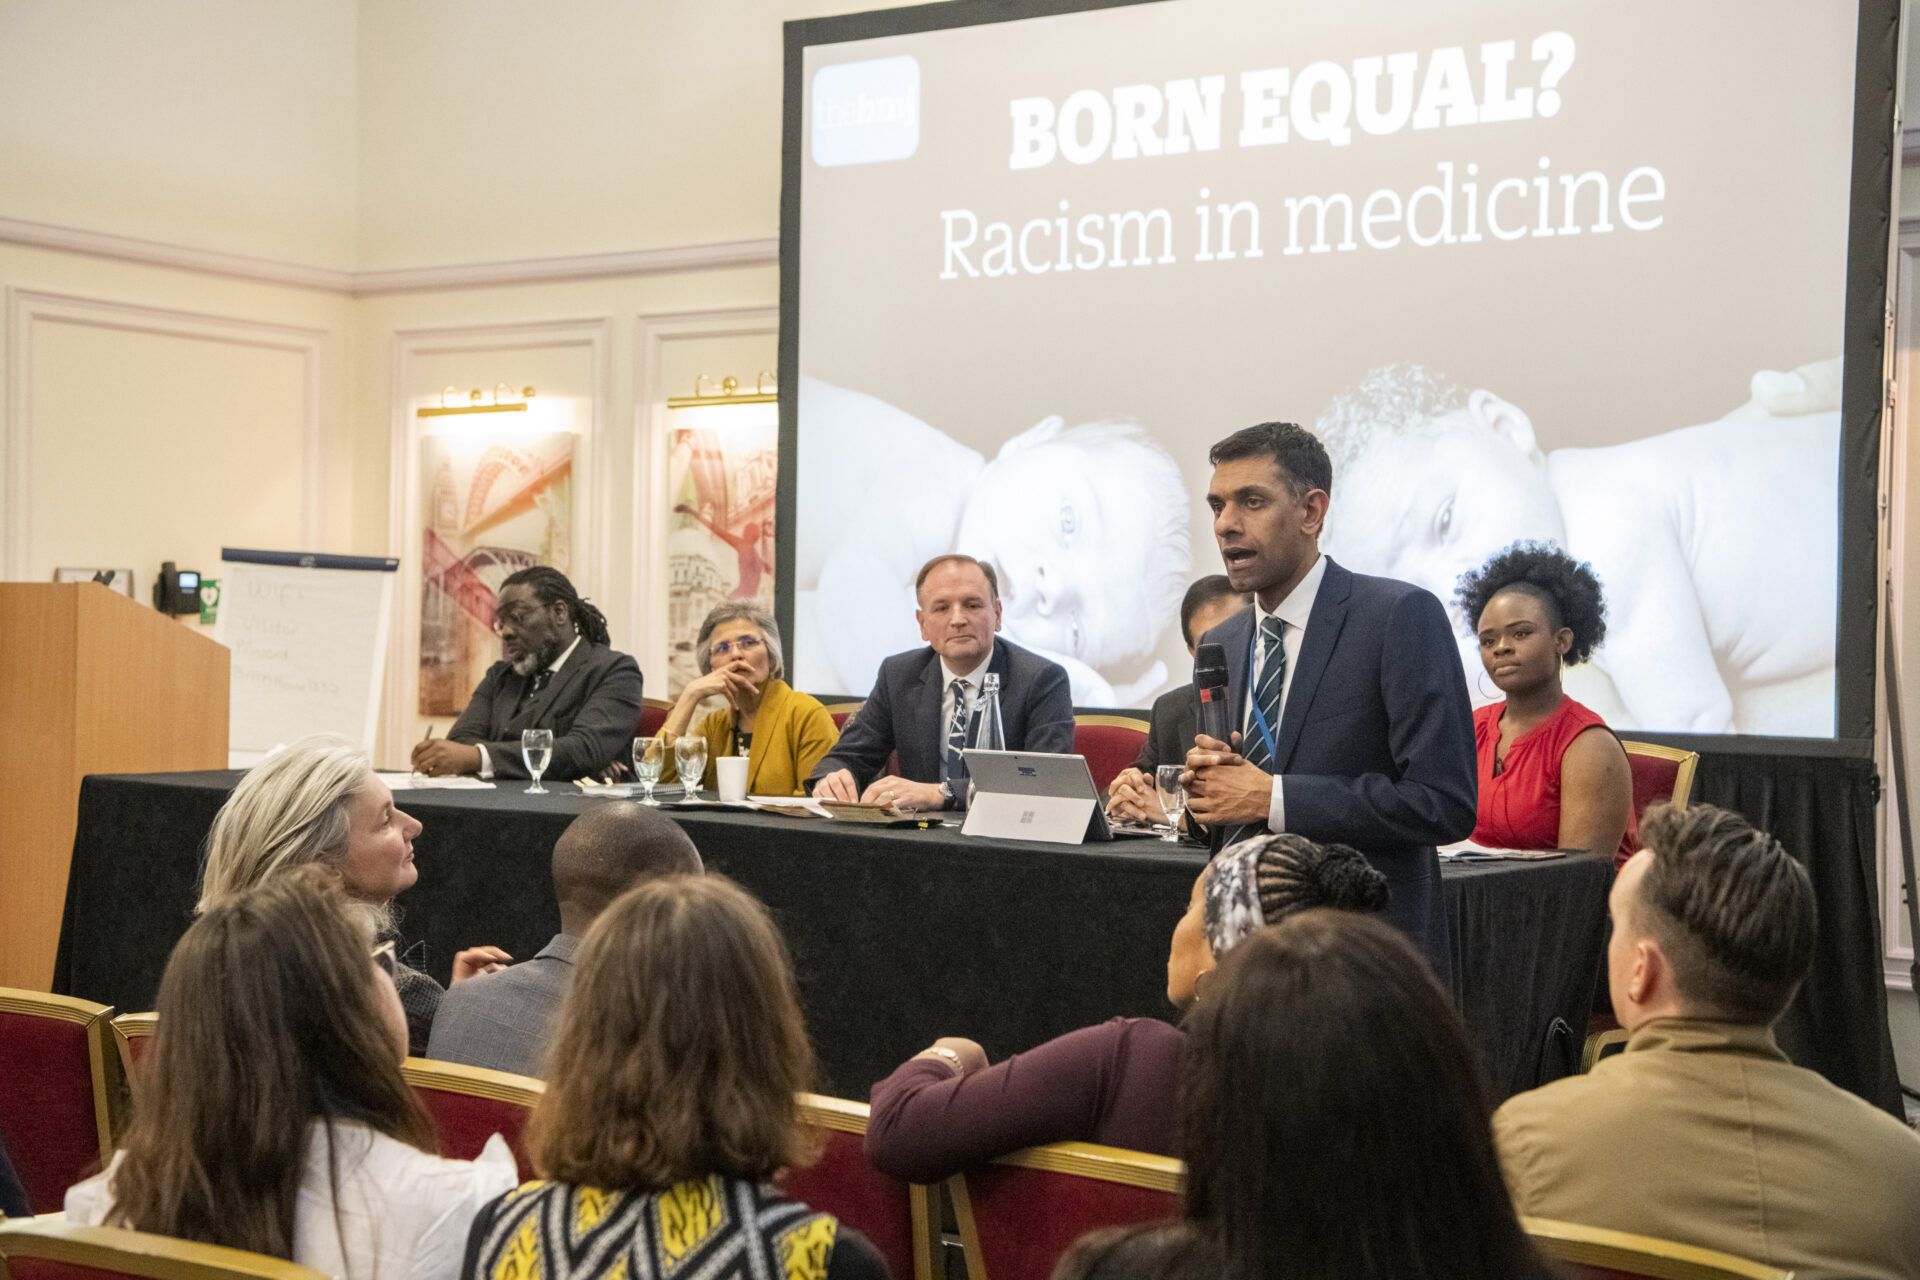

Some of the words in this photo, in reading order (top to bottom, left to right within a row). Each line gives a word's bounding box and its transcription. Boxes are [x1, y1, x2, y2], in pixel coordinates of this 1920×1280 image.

[1009, 76, 1225, 170] BORN
[1240, 33, 1575, 146] EQUAL?
[941, 201, 1176, 280] Racism
[1195, 187, 1264, 260] in
[1284, 157, 1665, 255] medicine
